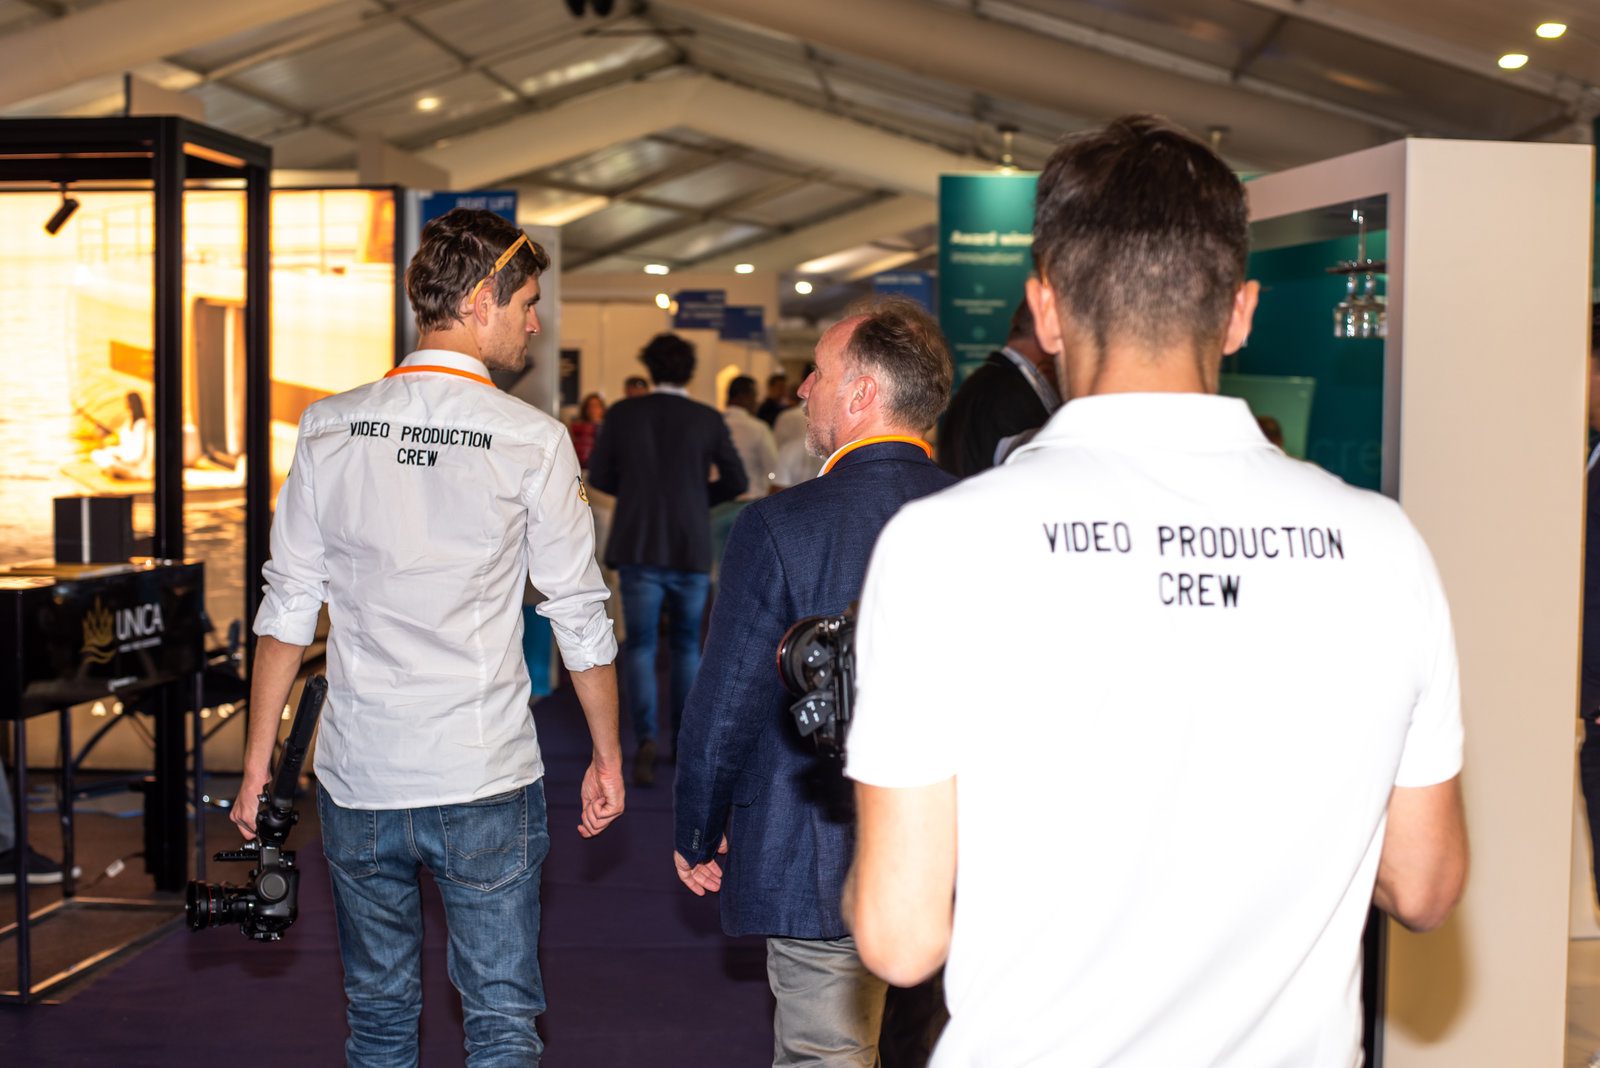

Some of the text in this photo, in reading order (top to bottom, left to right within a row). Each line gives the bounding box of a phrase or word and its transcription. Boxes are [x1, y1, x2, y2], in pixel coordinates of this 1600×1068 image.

[350, 420, 493, 450] VIDEO PRODUCTION
[397, 447, 439, 467] CREW
[1043, 521, 1346, 560] VIDEO PRODUCTION
[1159, 572, 1241, 608] CREW
